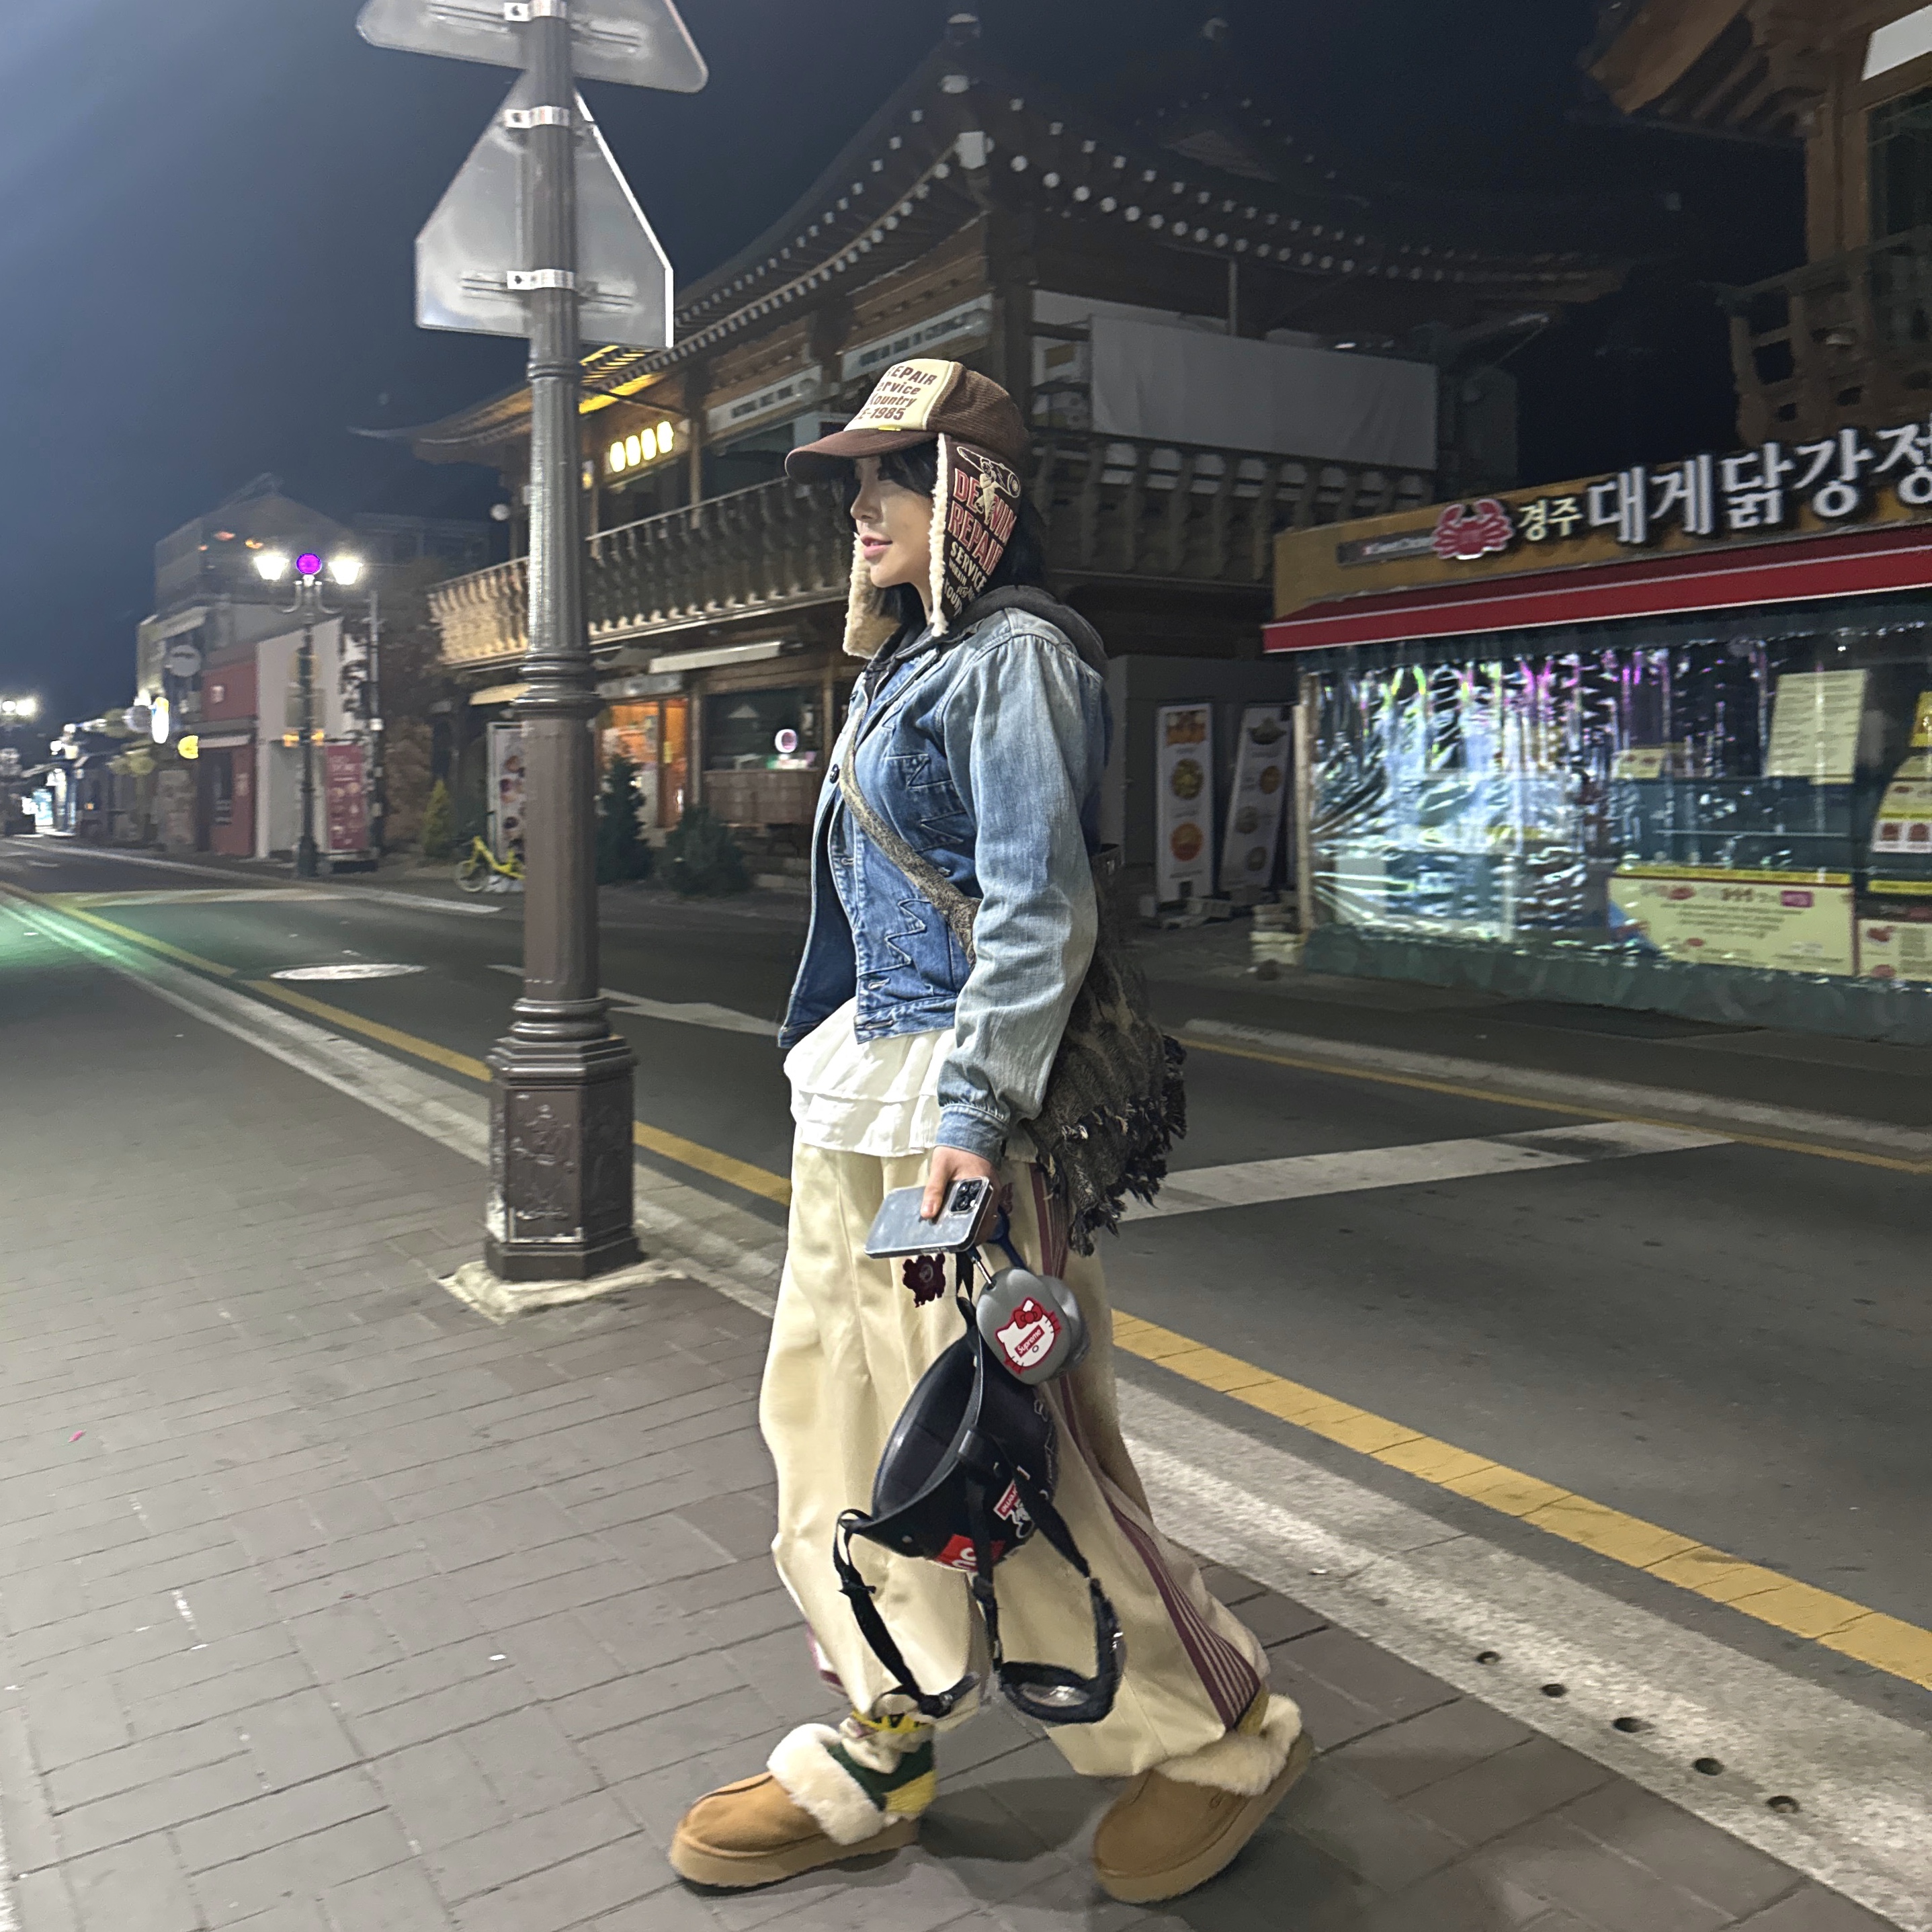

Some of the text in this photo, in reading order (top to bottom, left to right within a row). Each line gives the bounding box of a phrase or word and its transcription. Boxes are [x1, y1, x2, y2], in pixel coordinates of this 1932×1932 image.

[876, 381, 921, 395] ervice
[1517, 412, 1932, 543] 경주 대게닭강정
[950, 541, 987, 593] SERVICE
[1017, 1329, 1042, 1355] Supreme
